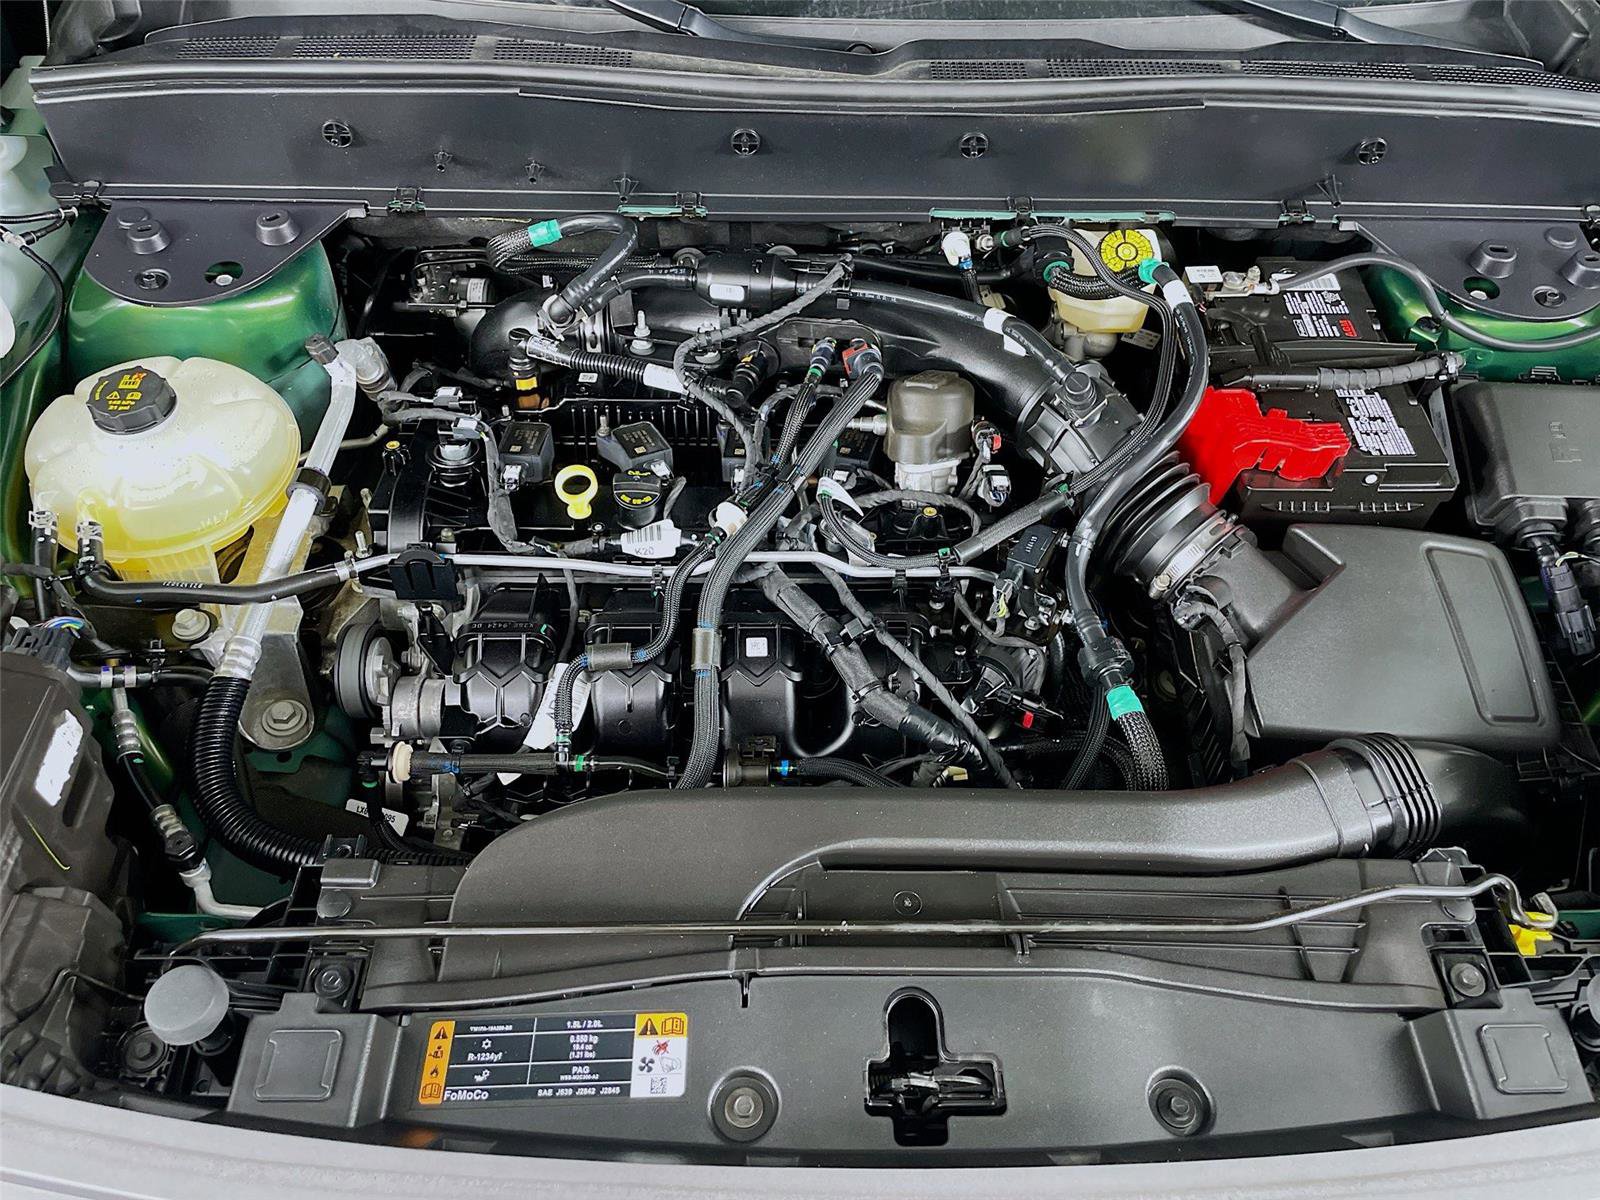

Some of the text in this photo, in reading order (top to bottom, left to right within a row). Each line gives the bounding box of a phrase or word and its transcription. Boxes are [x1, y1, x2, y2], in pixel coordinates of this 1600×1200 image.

[587, 1019, 603, 1028] 2.0L
[588, 1034, 599, 1044] kg
[467, 1052, 503, 1062] R-1234yf
[571, 1065, 590, 1074] PAG
[444, 1089, 489, 1101] FoMoCo
[537, 1088, 553, 1097] SAE
